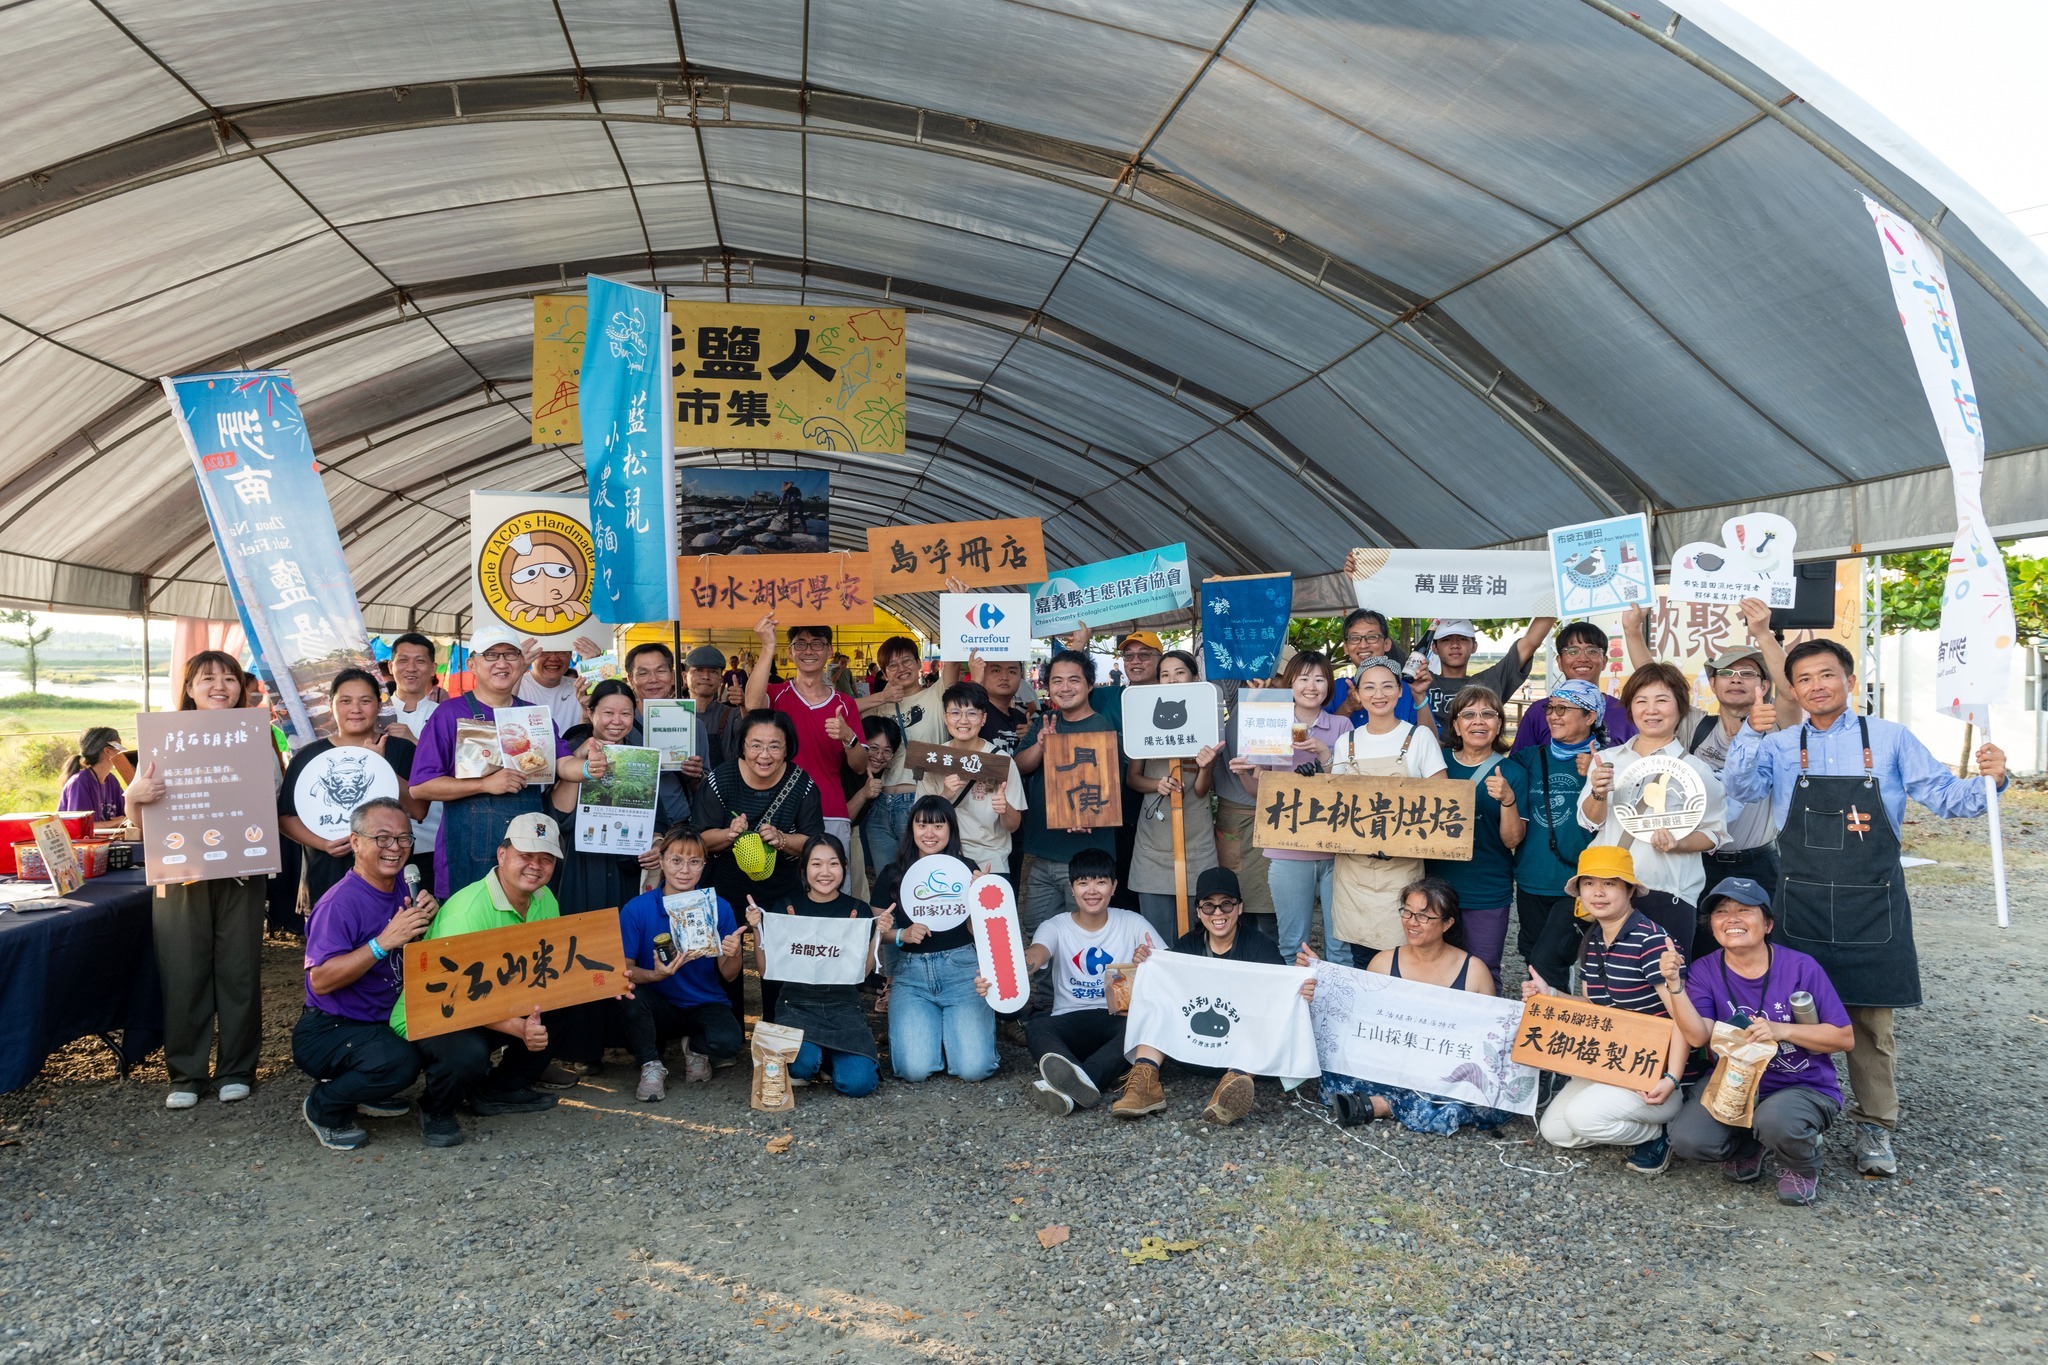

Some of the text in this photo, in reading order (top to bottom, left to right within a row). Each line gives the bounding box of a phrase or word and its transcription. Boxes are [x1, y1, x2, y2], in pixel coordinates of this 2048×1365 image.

[677, 388, 772, 428] 市集
[623, 390, 650, 533] 藍松鼠
[486, 519, 532, 557] TACO's
[536, 515, 595, 564] Handmade
[890, 535, 1027, 575] 島呼冊店
[484, 561, 503, 604] Uncle
[690, 574, 867, 611] 白水湖蚵學家
[1034, 567, 1182, 614] 嘉義縣生態保育協會
[1414, 573, 1508, 596] 萬豐醬油
[1054, 613, 1076, 624] County
[1077, 605, 1109, 617] Ecological
[1109, 598, 1149, 611] Conservation
[1150, 589, 1187, 602] Association
[960, 633, 1010, 643] Carrefour
[1265, 788, 1468, 840] 村上桃貴烘焙
[913, 902, 966, 917] 邱家兄弟
[790, 942, 840, 958] 拾間文化
[1070, 977, 1104, 987] Carref
[1351, 1021, 1473, 1060] 上山採集工作室
[1519, 1026, 1660, 1079] 天御梅製所
